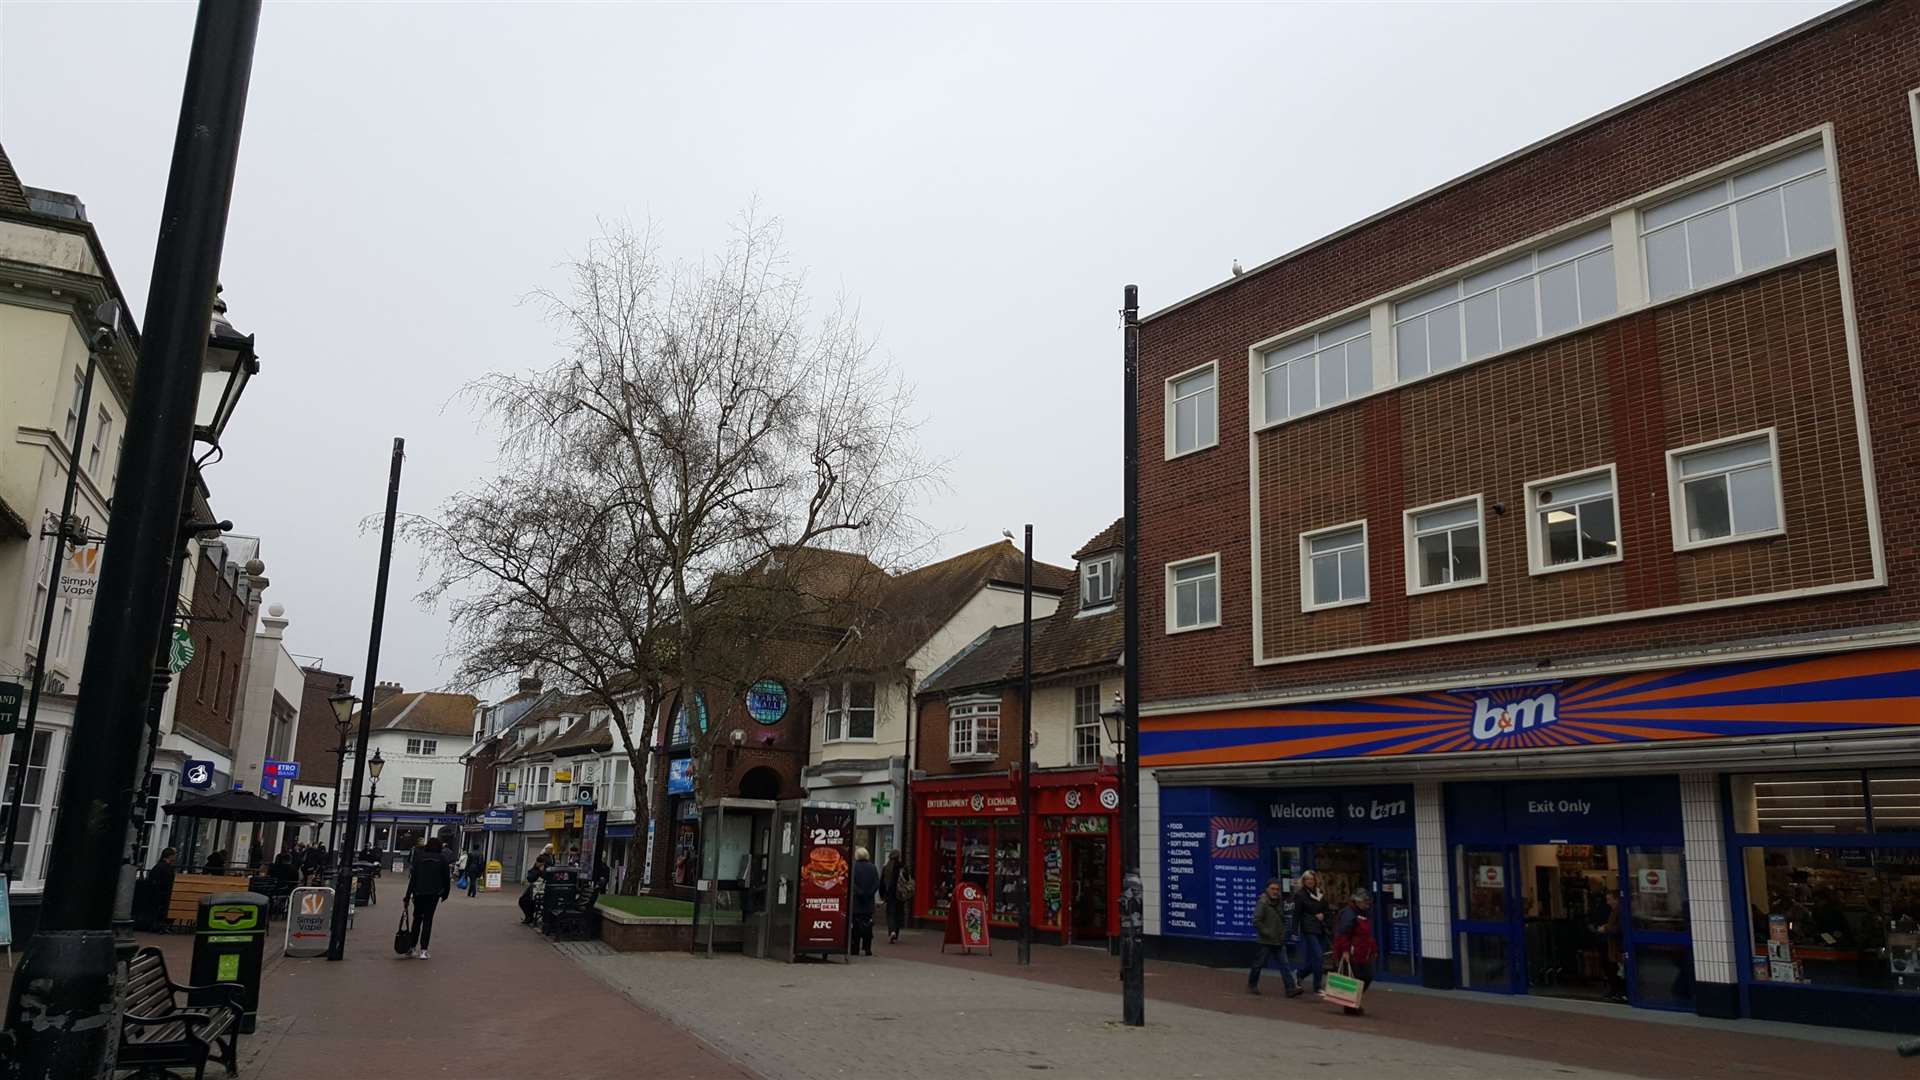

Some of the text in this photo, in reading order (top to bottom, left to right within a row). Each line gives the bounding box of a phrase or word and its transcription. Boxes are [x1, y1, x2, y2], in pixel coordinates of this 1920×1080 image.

[61, 576, 97, 590] Simply
[63, 585, 94, 596] Vape
[1472, 693, 1558, 740] b&m
[298, 791, 327, 808] M&S
[927, 798, 969, 809] ENTERTAINMENT
[986, 796, 1017, 807] EXCHANGE
[1269, 803, 1336, 818] Welcome
[1348, 804, 1366, 818] to
[1528, 800, 1591, 815] Exit Only
[297, 916, 323, 926] Simply
[299, 923, 322, 931] Vape
[813, 920, 832, 929] KFC
